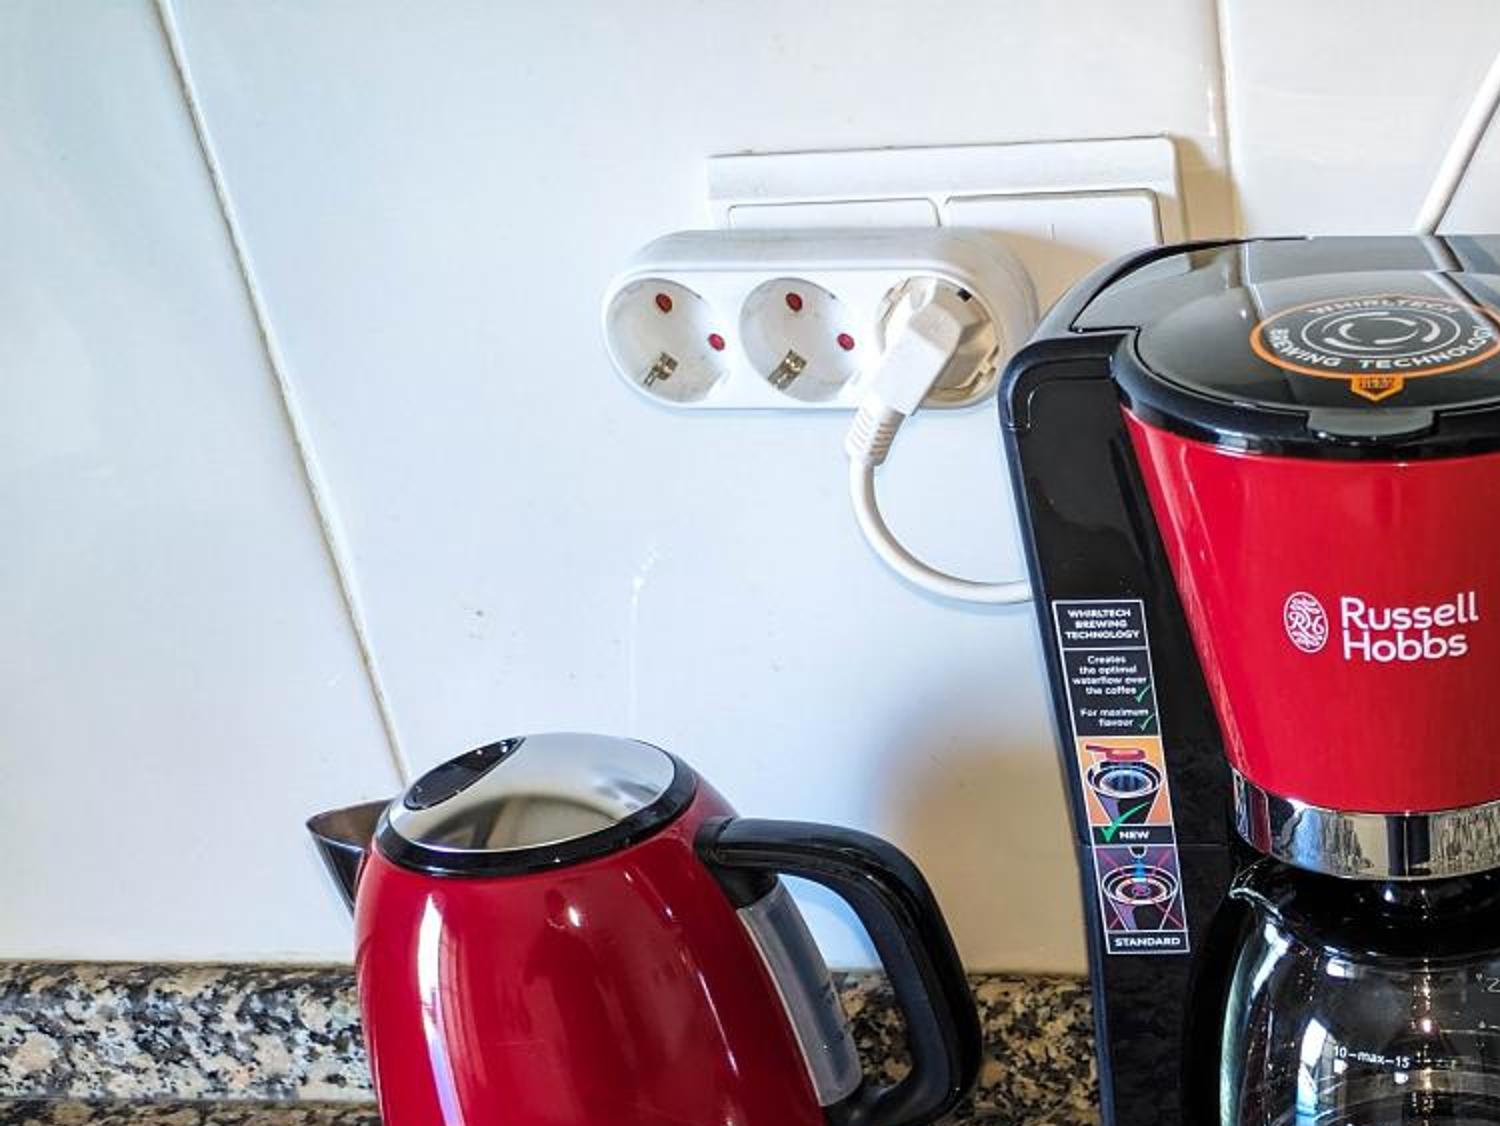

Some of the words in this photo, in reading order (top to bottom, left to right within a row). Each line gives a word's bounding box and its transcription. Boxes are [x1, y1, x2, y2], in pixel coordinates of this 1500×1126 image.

[1269, 327, 1341, 368] BREWING
[1359, 323, 1494, 370] TECHNOLOGY
[1067, 608, 1131, 618] WHIRLTECH
[1340, 591, 1479, 631] Russell
[1075, 619, 1128, 629] BREWING
[1065, 630, 1140, 639] TECHNOLOGY
[1342, 630, 1468, 662] Hobbs
[1087, 655, 1127, 664] Creates
[1079, 665, 1096, 675] the
[1098, 664, 1137, 675] optimal
[1072, 676, 1122, 685] waterflow
[1125, 676, 1147, 684] over
[1085, 687, 1102, 695] the
[1105, 686, 1137, 695] coffee
[1080, 708, 1097, 717] For
[1100, 708, 1149, 717] maximum
[1098, 718, 1135, 727] flavour
[1118, 830, 1150, 840] NEW
[1114, 936, 1181, 948] STANDARD
